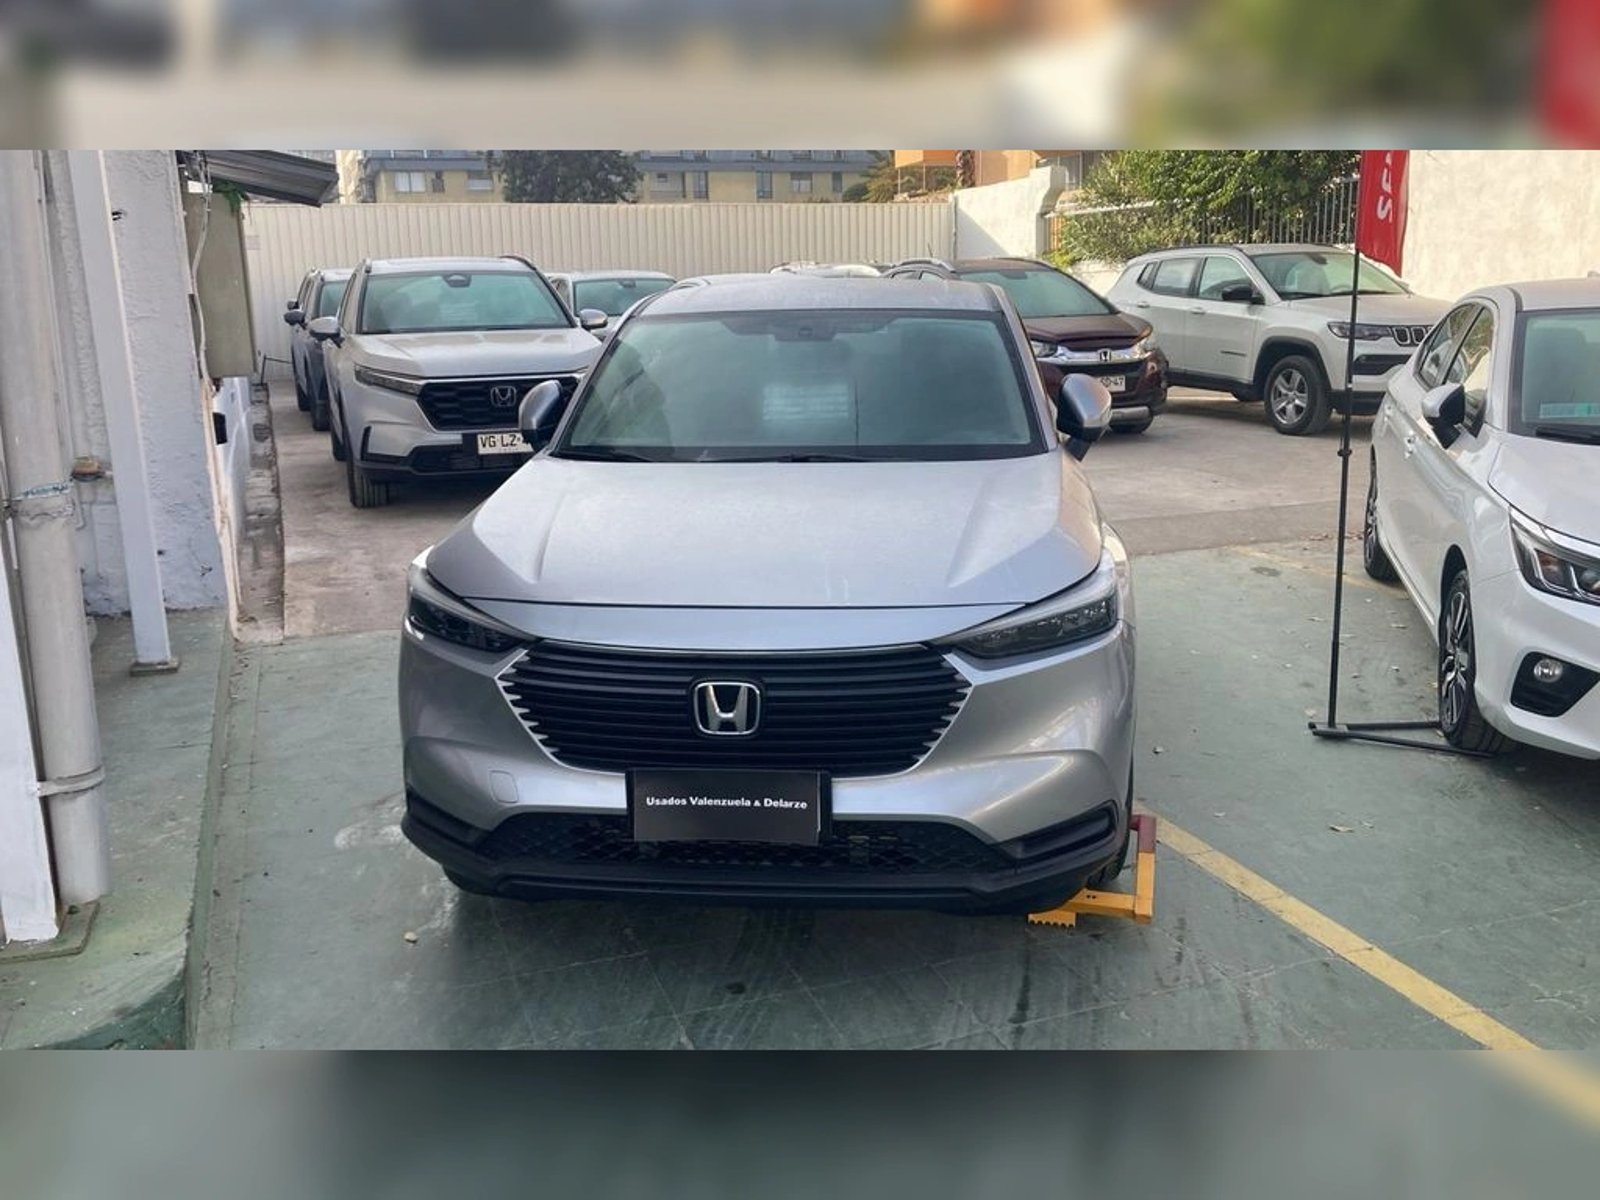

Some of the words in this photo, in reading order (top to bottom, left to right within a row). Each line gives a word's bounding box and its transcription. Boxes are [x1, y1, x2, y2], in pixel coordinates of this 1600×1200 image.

[645, 796, 687, 807] Usados
[689, 796, 751, 808] Valenzuela
[753, 799, 762, 808] &
[763, 797, 809, 810] Delarze
